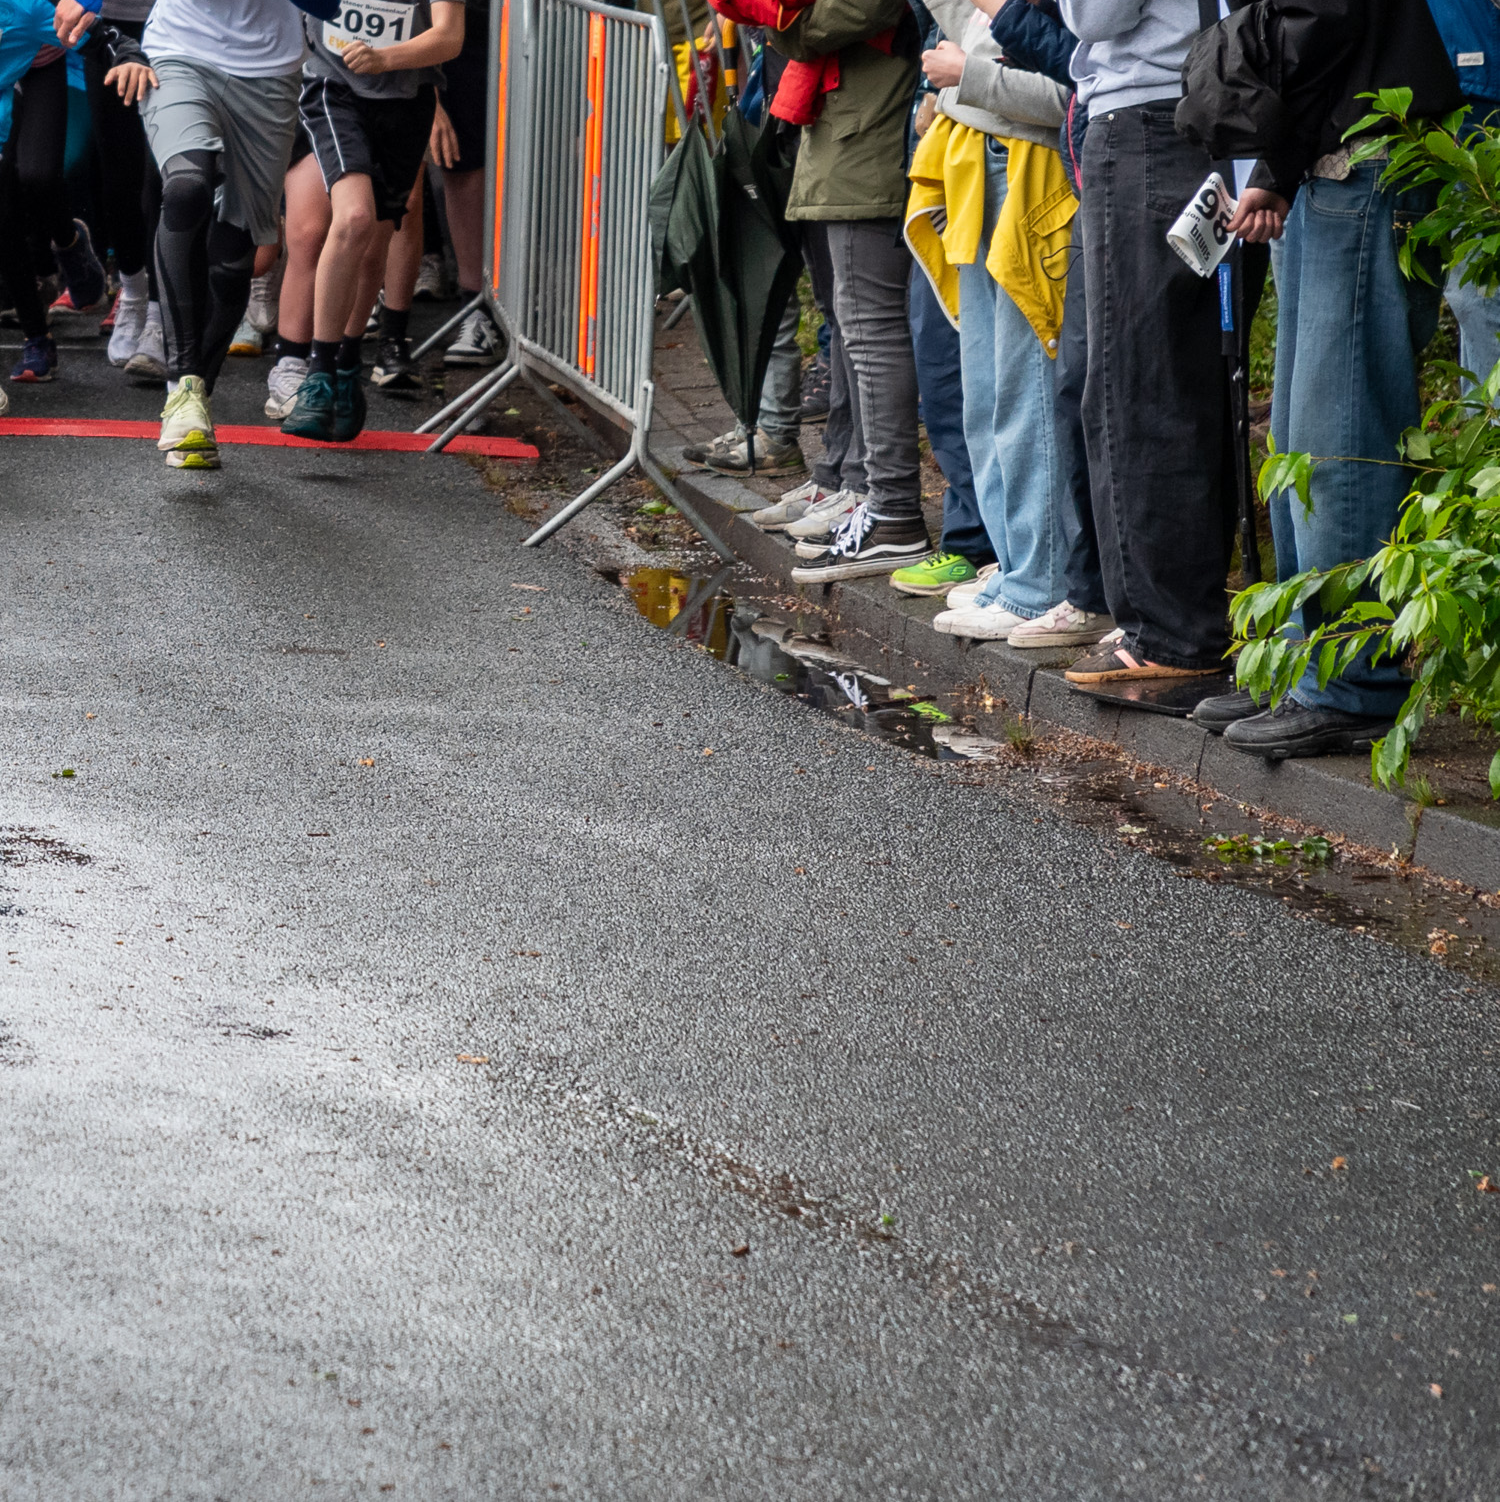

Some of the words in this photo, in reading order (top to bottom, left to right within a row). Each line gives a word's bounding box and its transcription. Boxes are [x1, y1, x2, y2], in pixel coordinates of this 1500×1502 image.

[325, 7, 405, 42] 2091
[328, 35, 349, 49] EW
[1189, 223, 1212, 262] bruns
